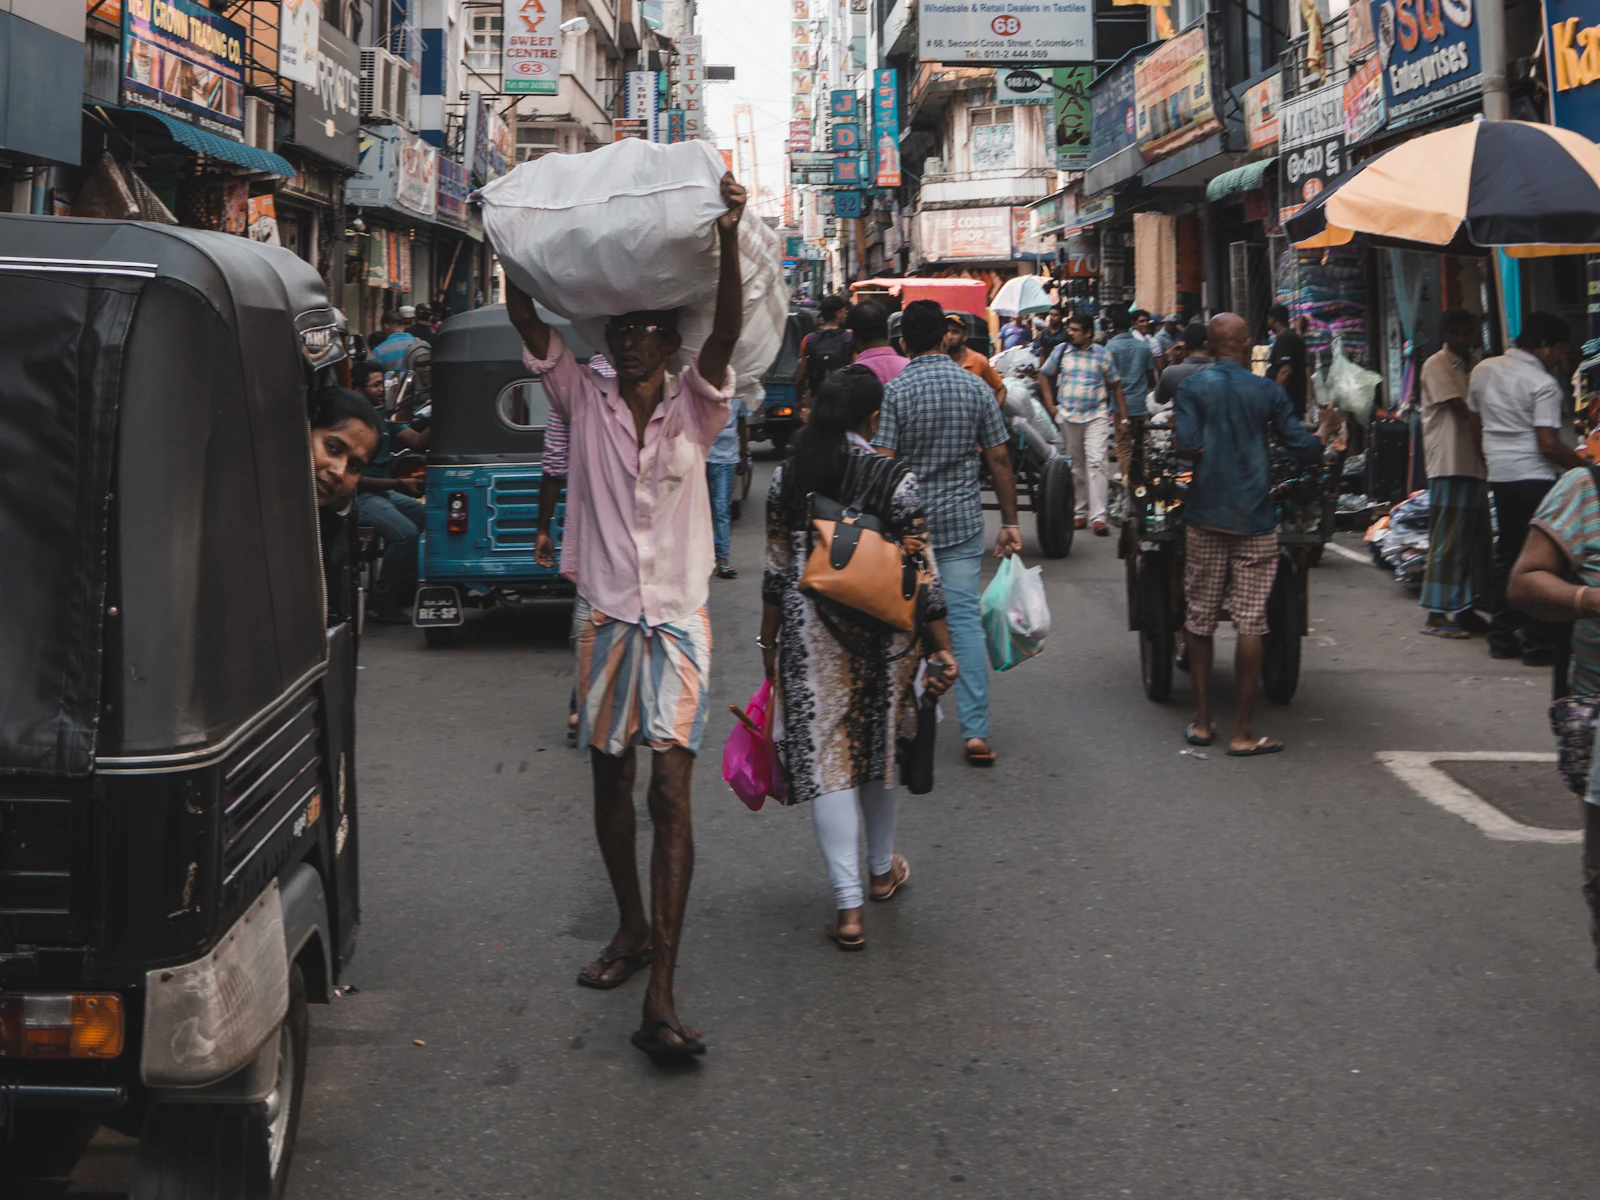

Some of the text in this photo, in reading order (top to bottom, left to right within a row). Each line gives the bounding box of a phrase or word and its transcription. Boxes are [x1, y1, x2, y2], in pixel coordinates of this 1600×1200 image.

[923, 3, 1087, 13] Wholesale & Retail Dealers in Textiles
[994, 17, 1020, 34] 68
[189, 15, 227, 59] TRADING
[228, 36, 243, 66] CO.
[510, 35, 554, 46] SWEET
[947, 38, 979, 48] Second
[980, 39, 1004, 48] Cross
[1007, 39, 1033, 49] Street,
[506, 48, 558, 59] CENTRE
[792, 0, 810, 113] RAMYA
[964, 50, 981, 59] Tel:
[520, 63, 543, 73] 63
[1389, 40, 1470, 97] Enterprises
[682, 53, 700, 111] FIVE
[835, 94, 857, 180] JDM
[838, 196, 857, 213] 92
[934, 214, 1004, 230] THE CORNER
[951, 229, 984, 243] SHOP
[1073, 253, 1099, 274] 70
